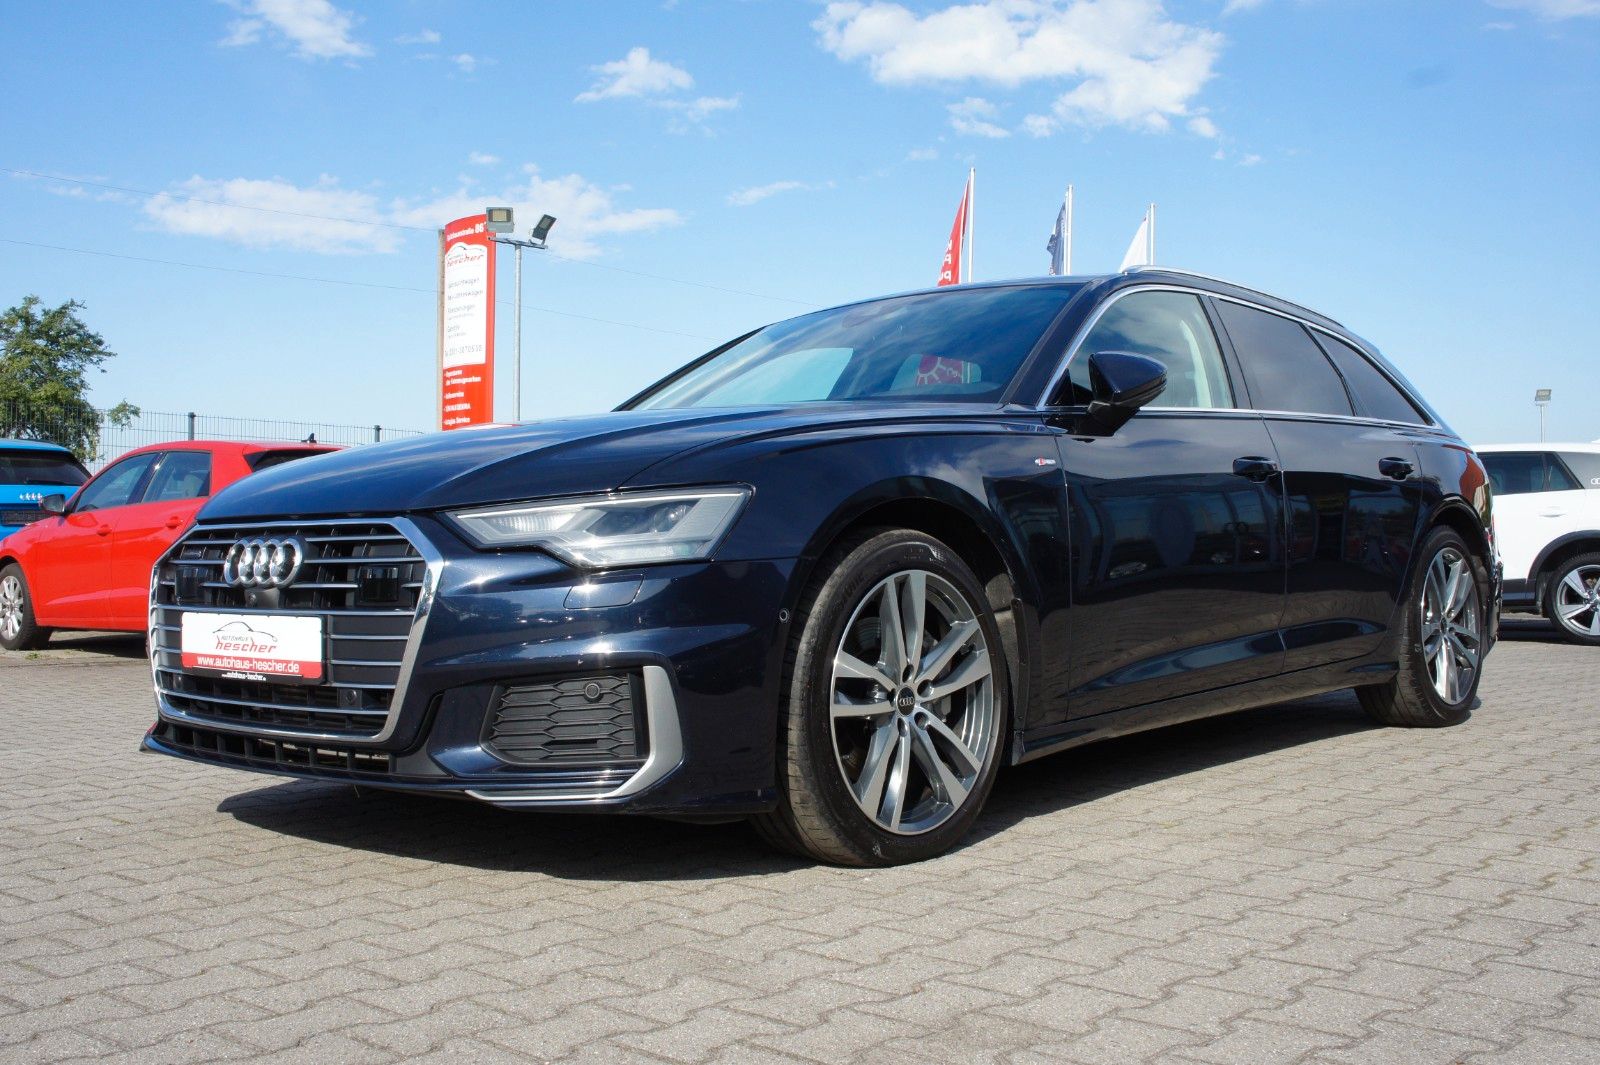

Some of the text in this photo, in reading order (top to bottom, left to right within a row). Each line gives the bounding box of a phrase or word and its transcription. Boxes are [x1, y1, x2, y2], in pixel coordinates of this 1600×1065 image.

[215, 635, 278, 653] hescher
[198, 656, 299, 673] www.autohaus-hescher.de
[221, 671, 267, 681] .autohaus-hescher.
